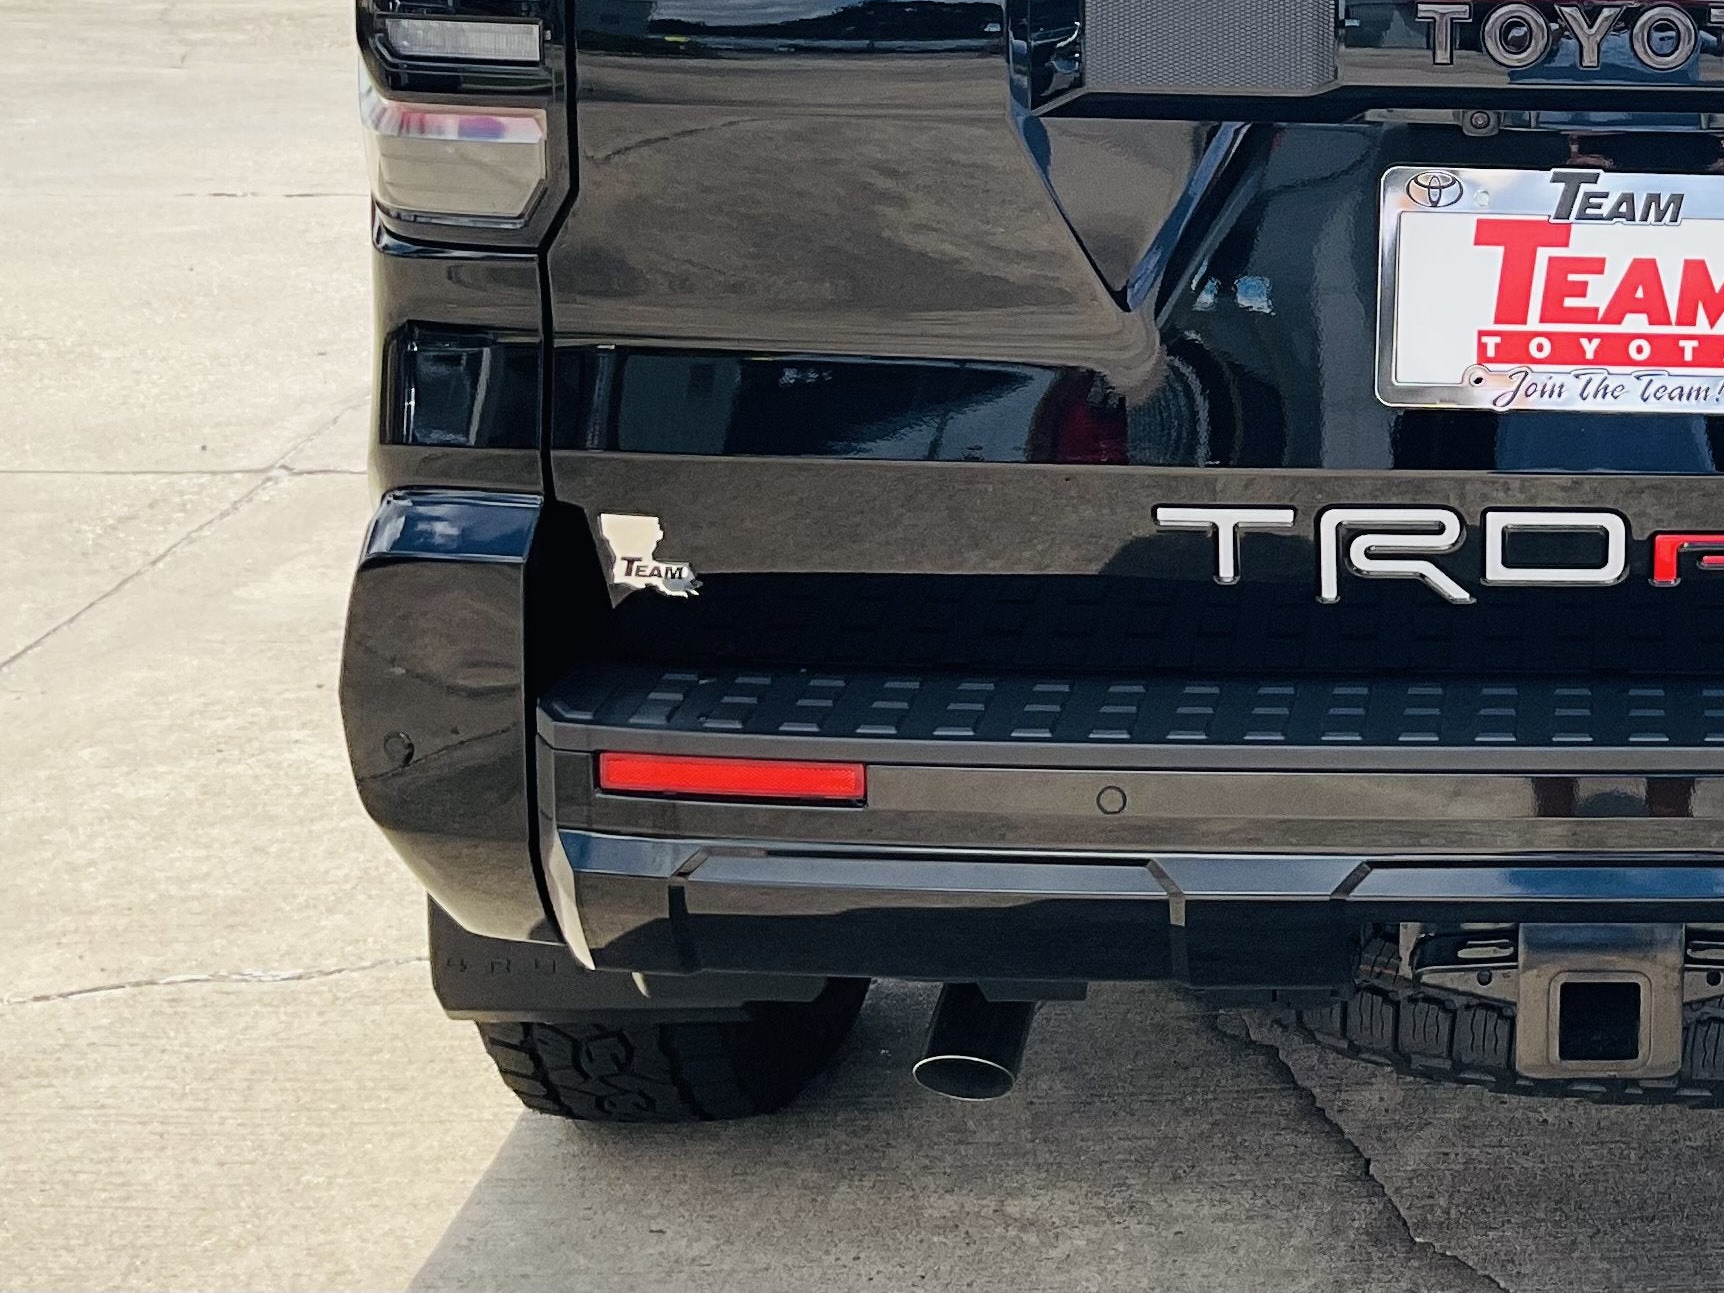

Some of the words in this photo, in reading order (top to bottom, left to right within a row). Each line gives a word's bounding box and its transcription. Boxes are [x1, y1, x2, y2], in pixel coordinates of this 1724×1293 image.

[1550, 172, 1685, 223] TEAM
[1492, 370, 1566, 408] Join
[1572, 371, 1630, 401] The
[621, 556, 684, 580] TEAM
[1154, 506, 1630, 604] TRD
